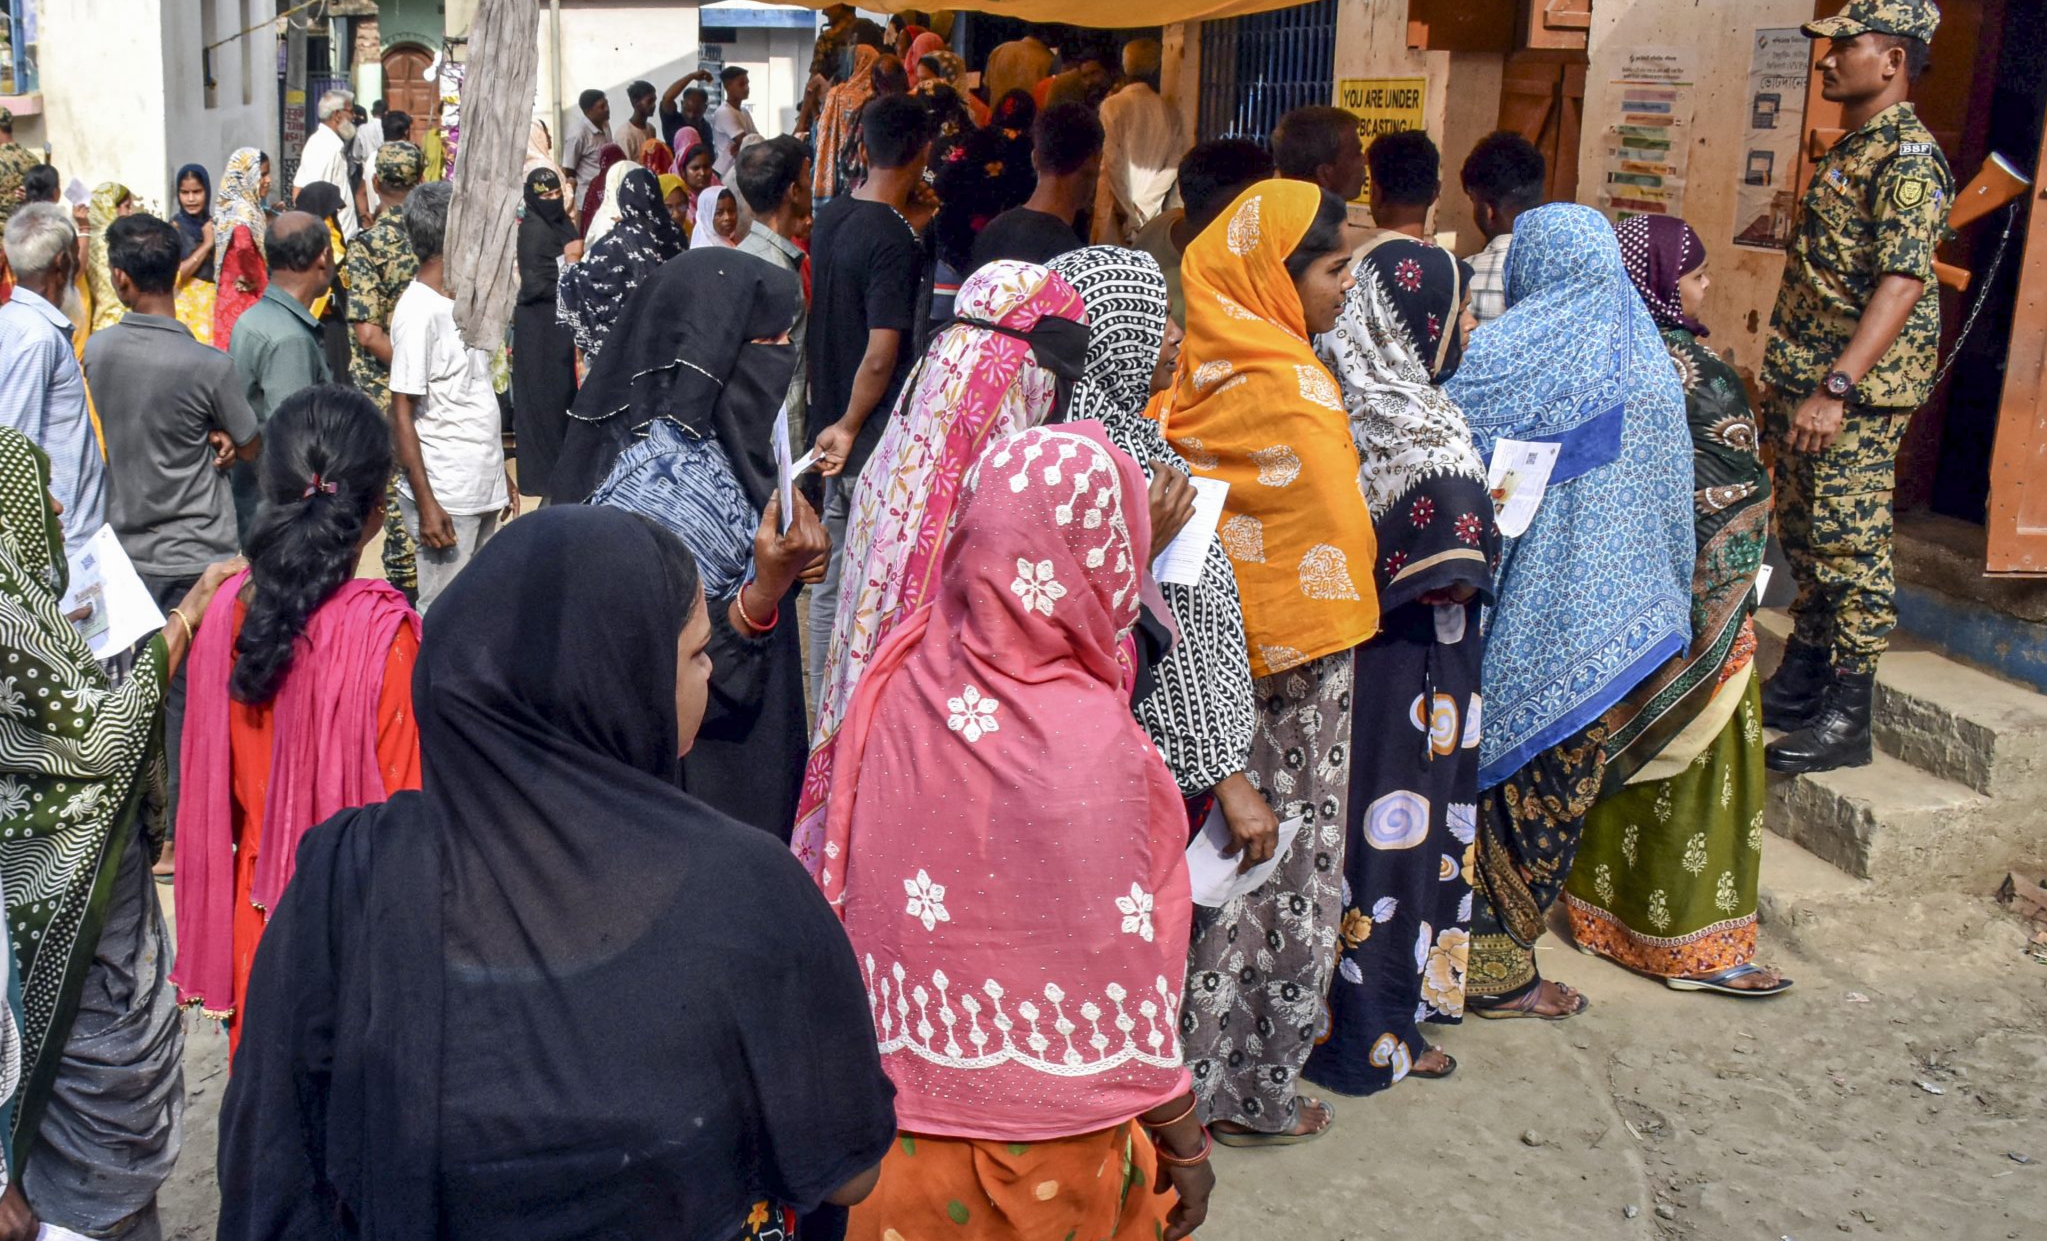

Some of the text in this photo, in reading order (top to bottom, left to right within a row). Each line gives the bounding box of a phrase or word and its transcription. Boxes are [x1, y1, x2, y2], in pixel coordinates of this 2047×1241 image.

[1344, 89, 1419, 108] YOU ARE UNDER
[1356, 118, 1406, 137] BCASTING
[1902, 145, 1929, 153] BSF
